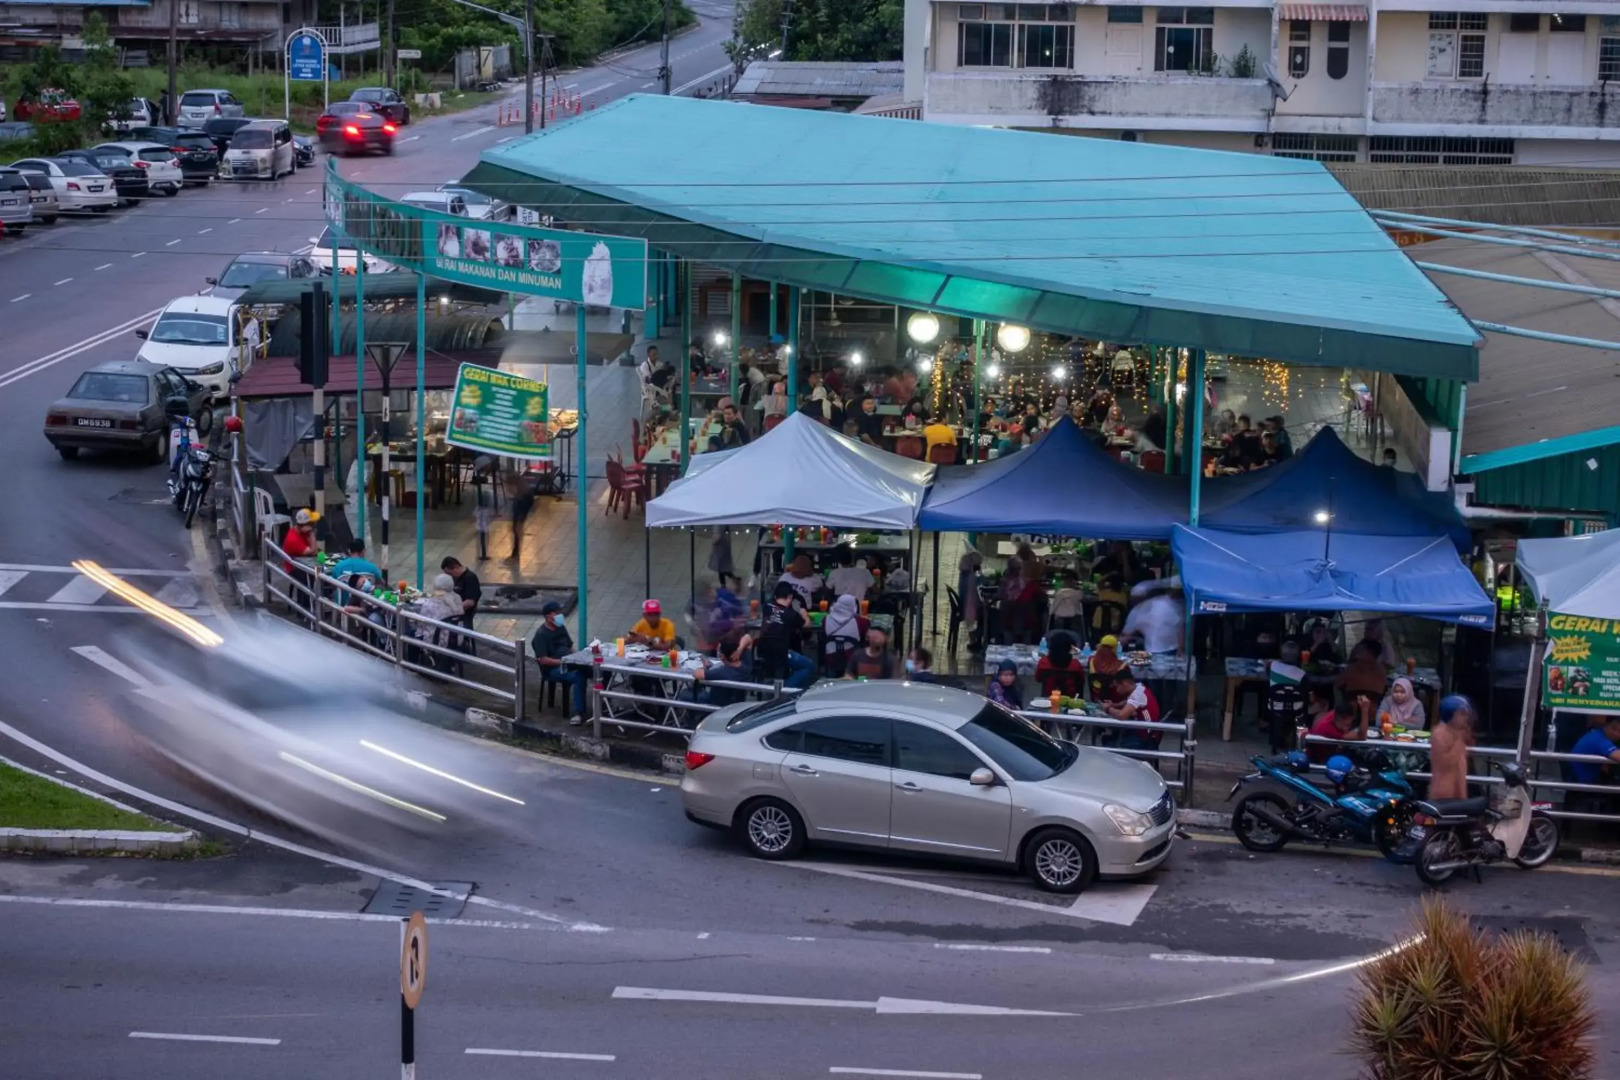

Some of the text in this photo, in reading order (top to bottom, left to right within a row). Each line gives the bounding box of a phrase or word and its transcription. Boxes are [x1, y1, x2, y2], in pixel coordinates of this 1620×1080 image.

[458, 261, 496, 280] MAKANAN
[497, 268, 516, 282] DAN
[519, 271, 562, 289] MINUMAN
[1550, 614, 1609, 633] GERAI
